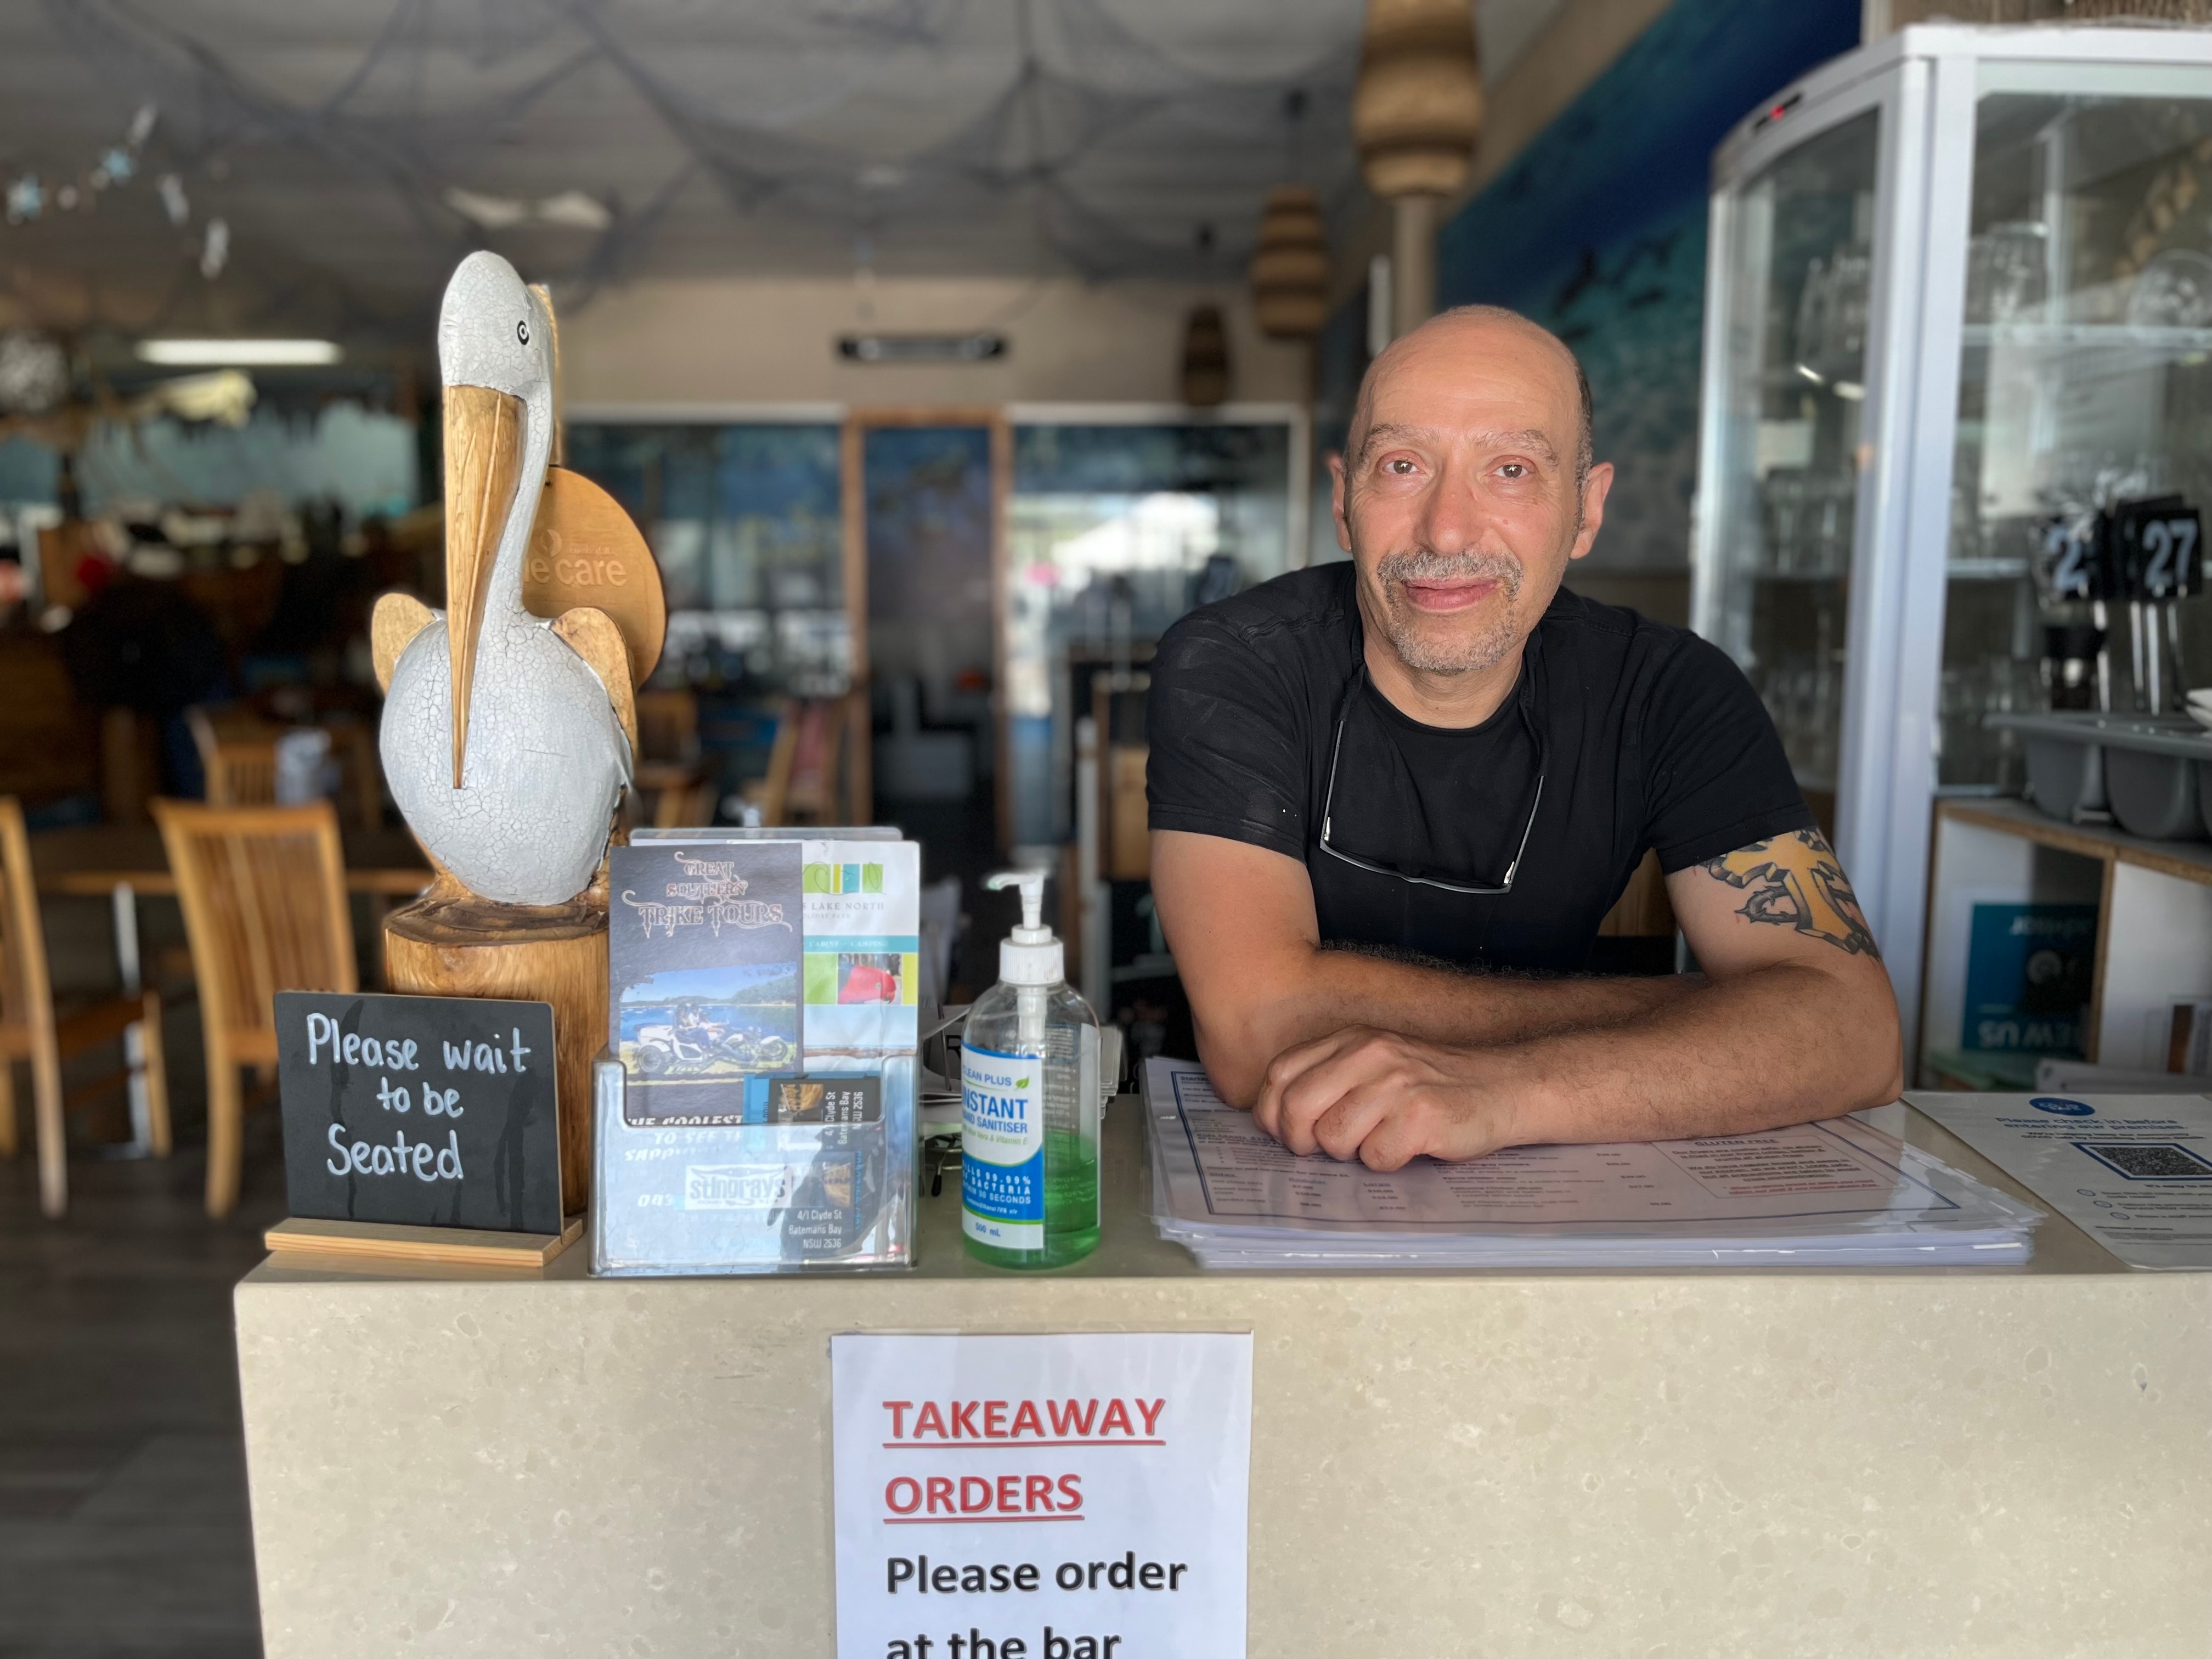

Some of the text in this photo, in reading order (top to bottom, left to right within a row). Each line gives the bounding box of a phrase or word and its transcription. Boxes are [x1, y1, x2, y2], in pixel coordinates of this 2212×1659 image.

[2142, 519, 2198, 589] 27
[555, 558, 627, 587] care
[678, 856, 735, 879] GREAT
[667, 879, 748, 901] SOUTHERN
[812, 902, 840, 910] LAKE
[845, 902, 884, 910] NORTH
[636, 902, 788, 937] TRIKE TOURS
[307, 1013, 531, 1074] Please wait
[985, 1074, 1012, 1086] PLUS
[376, 1076, 464, 1118] to be
[826, 1091, 836, 1100] St
[839, 1091, 851, 1105] Bay
[854, 1091, 864, 1109] 2536
[825, 1101, 836, 1122] Clyde
[977, 1116, 1028, 1133] SANITISER
[996, 1134, 1021, 1144] Vitamin
[327, 1123, 464, 1182] Seated
[972, 1176, 1030, 1194] BACTERIA
[985, 1172, 1031, 1184] 99.99%
[990, 1193, 1031, 1204] SECONDS
[811, 1210, 832, 1221] Clyde
[834, 1210, 842, 1219] St
[788, 1223, 842, 1234] Batemans Bay
[975, 1222, 1001, 1237] 500 mL
[803, 1238, 842, 1249] NSW 2536
[883, 1398, 1166, 1440] TAKEAWAY
[885, 1474, 1084, 1514] ORDERS
[886, 1550, 1188, 1593] Please order
[886, 1626, 1122, 1659] at the bar
